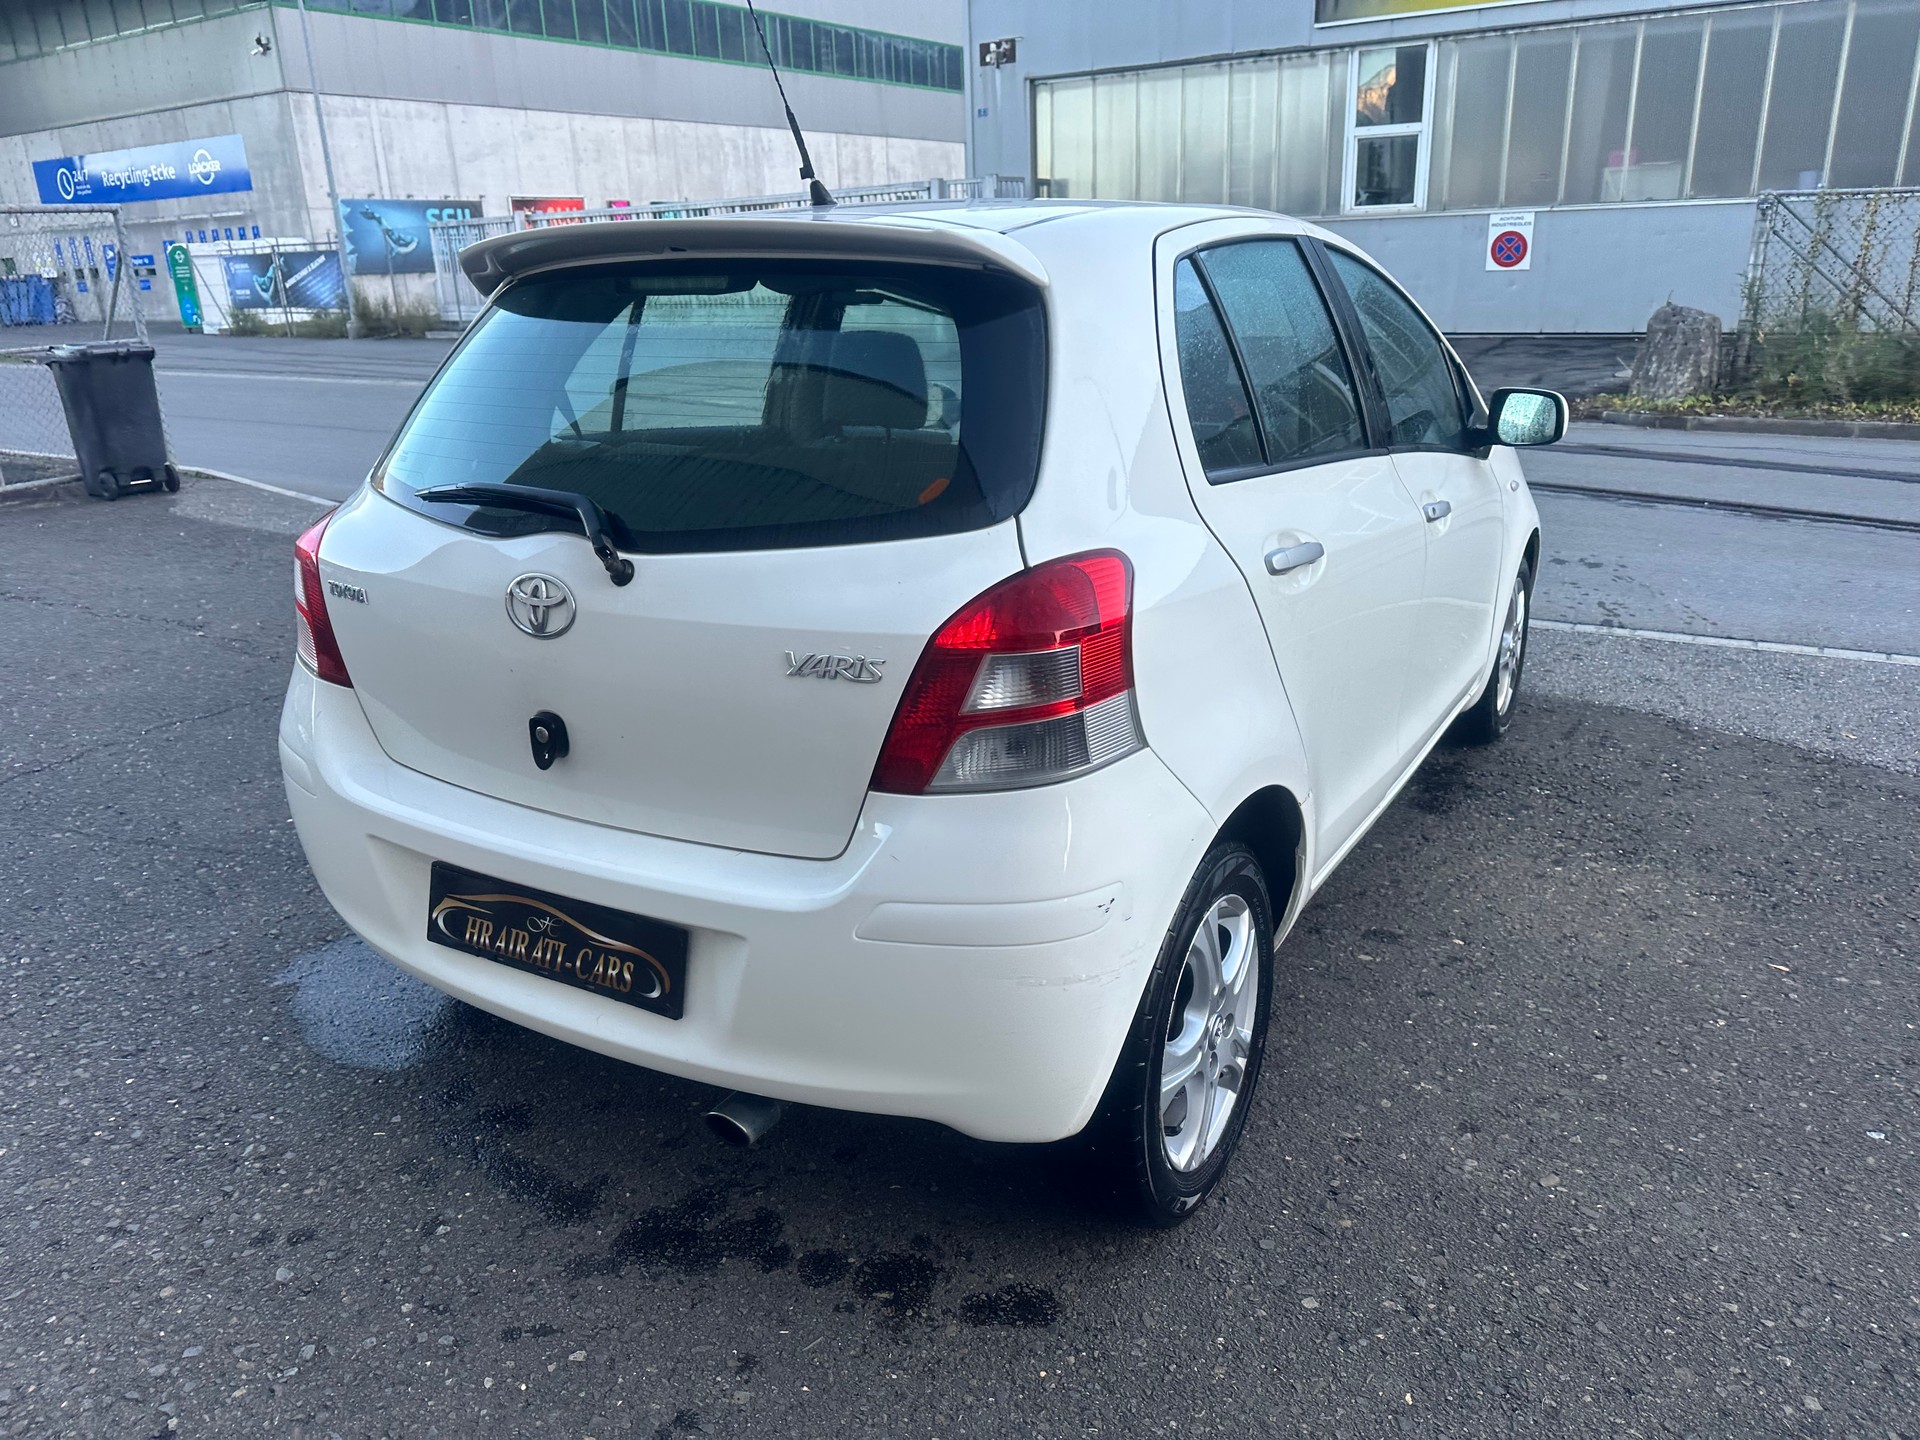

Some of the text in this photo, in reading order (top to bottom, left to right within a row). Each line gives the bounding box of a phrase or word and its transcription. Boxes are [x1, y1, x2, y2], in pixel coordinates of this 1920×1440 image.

[72, 160, 221, 189] 24/7 Recycling-Ecke LOACKER
[327, 579, 369, 605] TOYOTA
